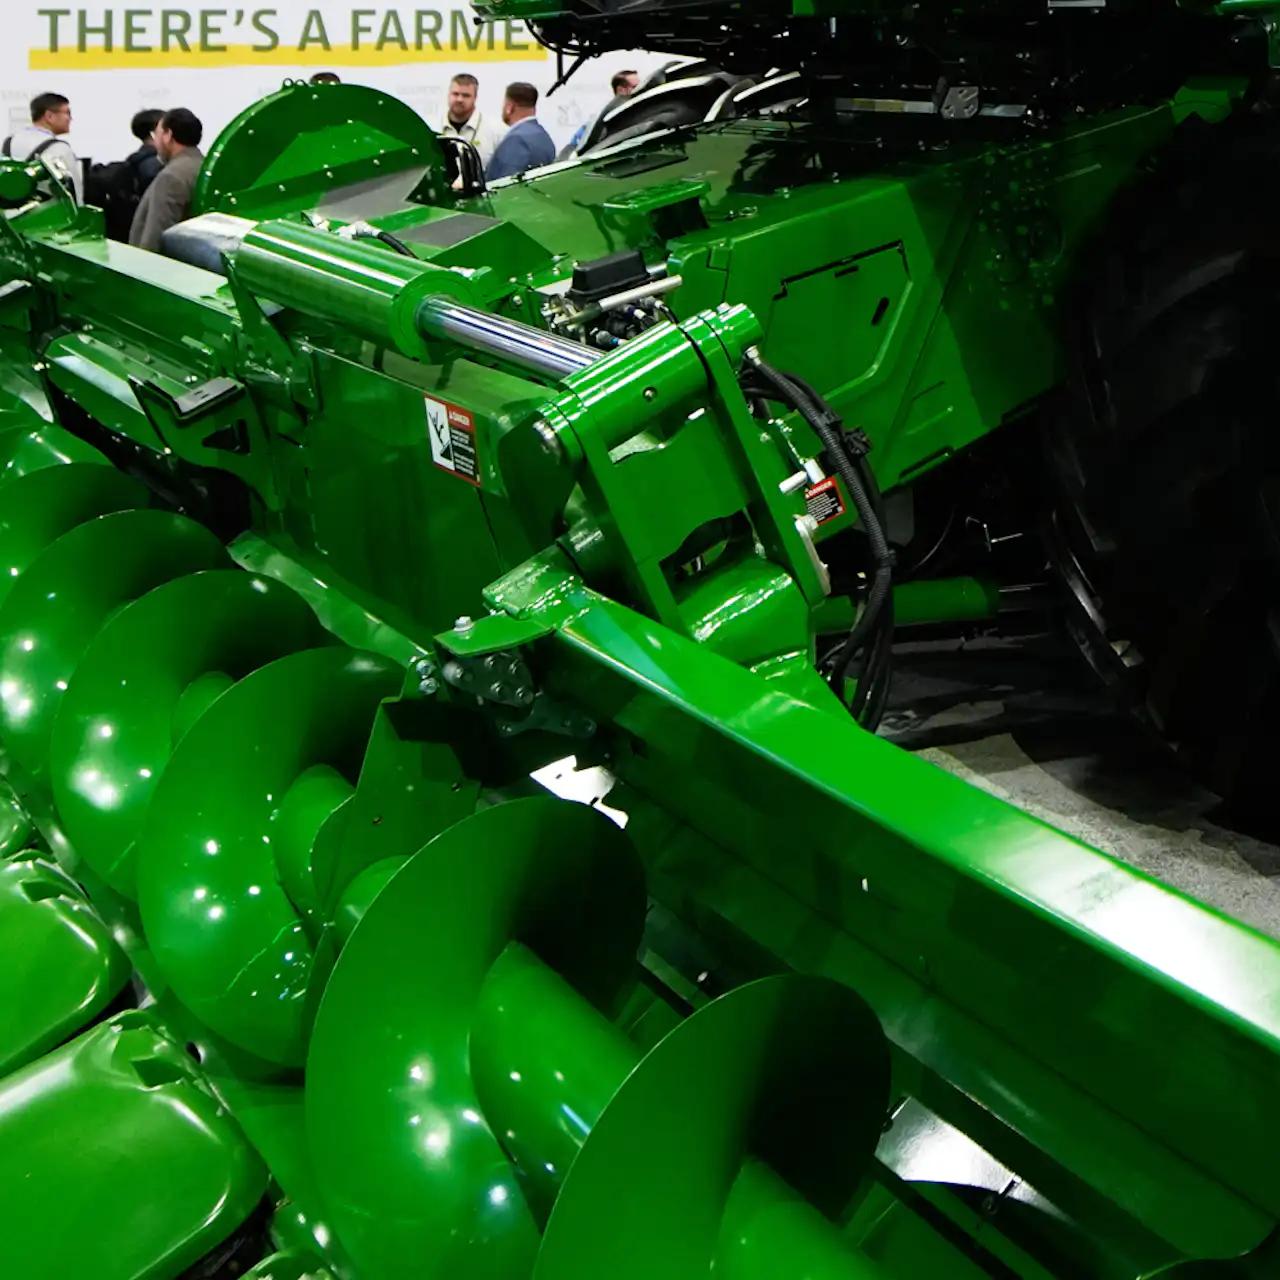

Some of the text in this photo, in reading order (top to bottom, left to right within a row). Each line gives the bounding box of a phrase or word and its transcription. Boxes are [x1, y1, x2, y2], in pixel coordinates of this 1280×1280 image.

[37, 8, 546, 53] THERE’S A FARME
